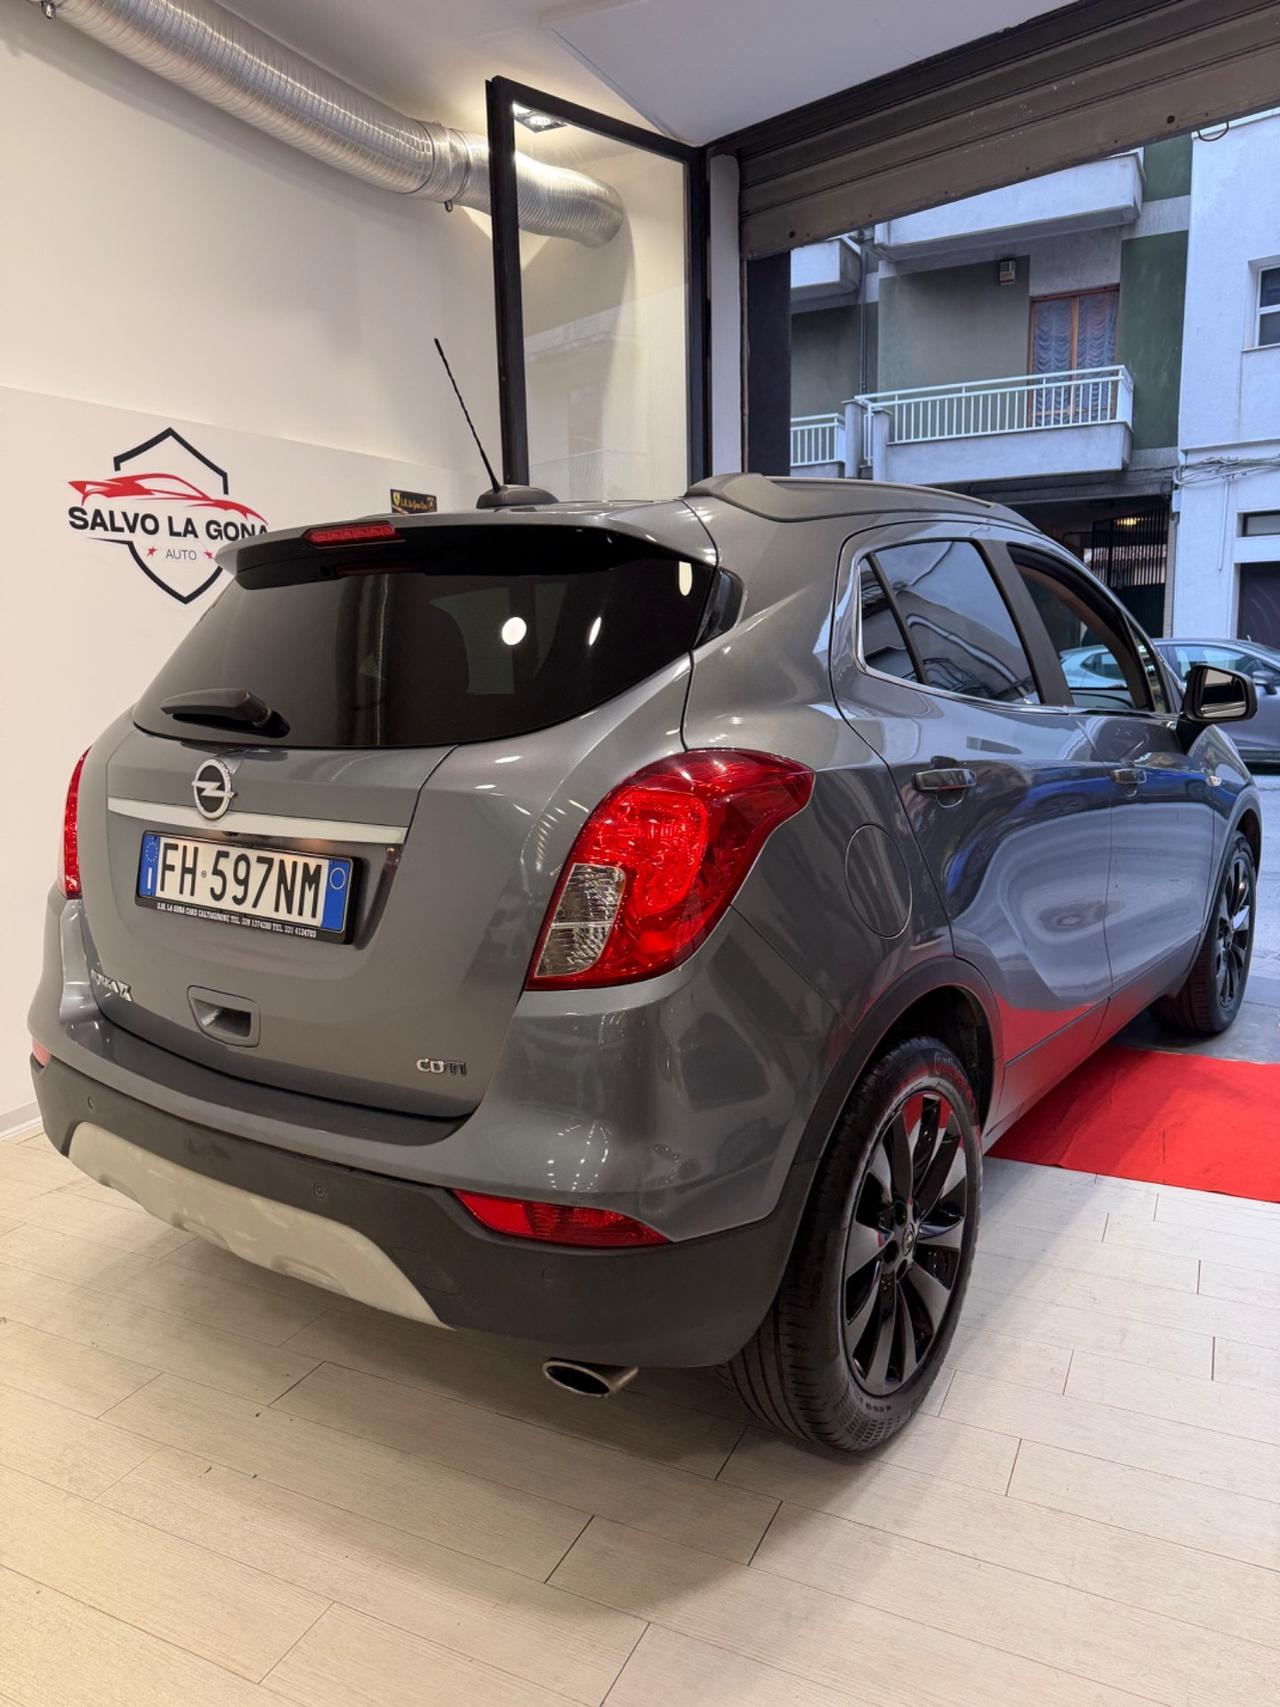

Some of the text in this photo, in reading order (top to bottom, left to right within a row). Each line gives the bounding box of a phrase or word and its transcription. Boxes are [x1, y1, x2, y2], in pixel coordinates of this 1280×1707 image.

[68, 506, 160, 536] SALVO
[167, 515, 199, 539] LA
[165, 549, 197, 561] AUTO
[159, 841, 323, 919] FH 597NM
